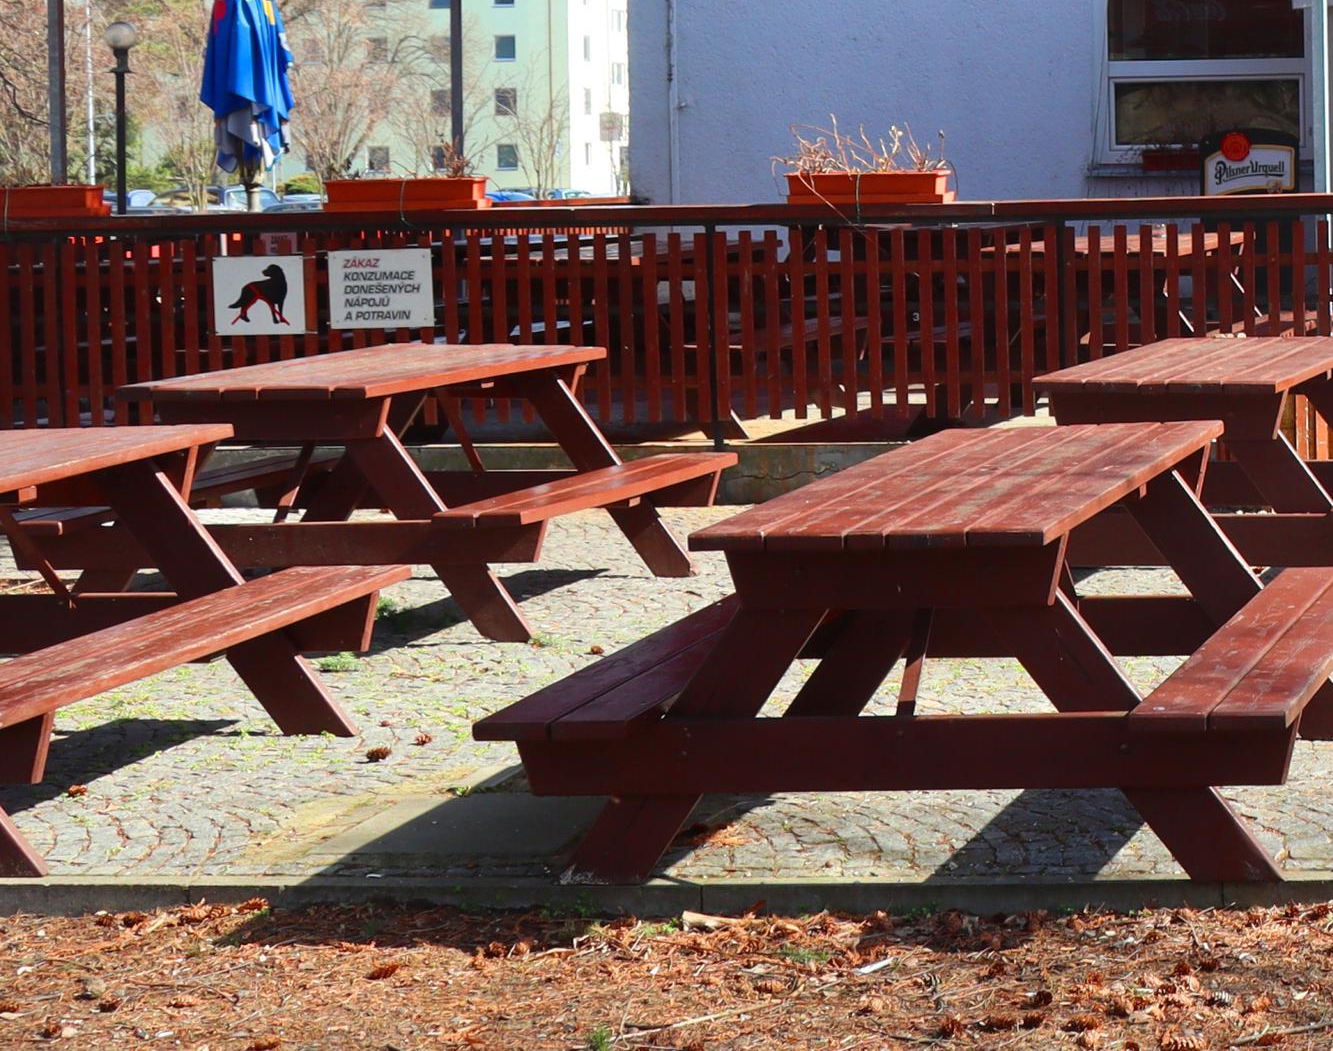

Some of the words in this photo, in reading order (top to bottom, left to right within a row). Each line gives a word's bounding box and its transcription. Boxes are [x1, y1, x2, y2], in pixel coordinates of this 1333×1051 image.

[1214, 160, 1251, 185] Pilsner
[1249, 160, 1285, 178] Urquell
[343, 258, 380, 268] ZÁKAZ
[343, 271, 415, 281] KONZUMACE
[344, 282, 421, 295] DONEŠENÝCH
[344, 295, 391, 308] NÁPOJŮ
[344, 311, 353, 321] A
[355, 310, 411, 321] POTRAVIN
[912, 312, 920, 322] 3
